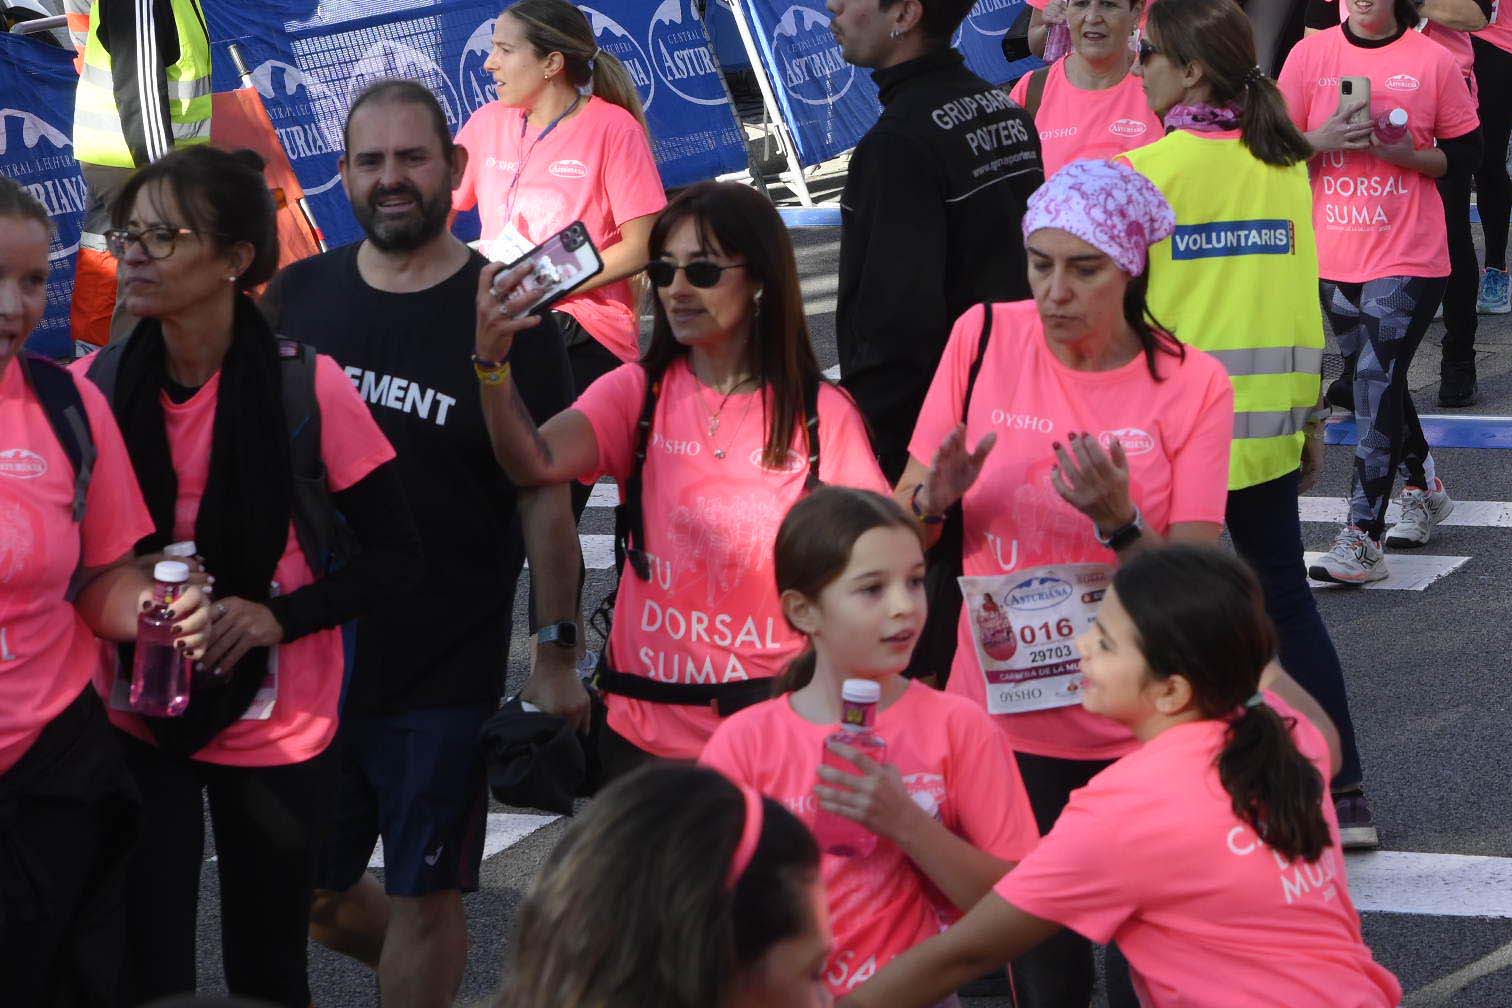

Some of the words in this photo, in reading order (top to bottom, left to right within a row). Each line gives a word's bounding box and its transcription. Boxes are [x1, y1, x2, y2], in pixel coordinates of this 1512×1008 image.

[931, 97, 978, 130] GRUP
[1040, 126, 1078, 140] OYSHO
[1323, 176, 1408, 197] DORSAL
[1326, 203, 1389, 225] SUMA
[1176, 228, 1288, 251] VOLUNTARIS
[991, 409, 1053, 433] OYSHO
[1011, 587, 1069, 606] ASTURIANA
[641, 599, 781, 649] DORSAL
[1020, 618, 1073, 645] 016
[639, 646, 750, 684] SUMA
[1030, 645, 1072, 663] 29703
[1000, 688, 1042, 702] OYSHO
